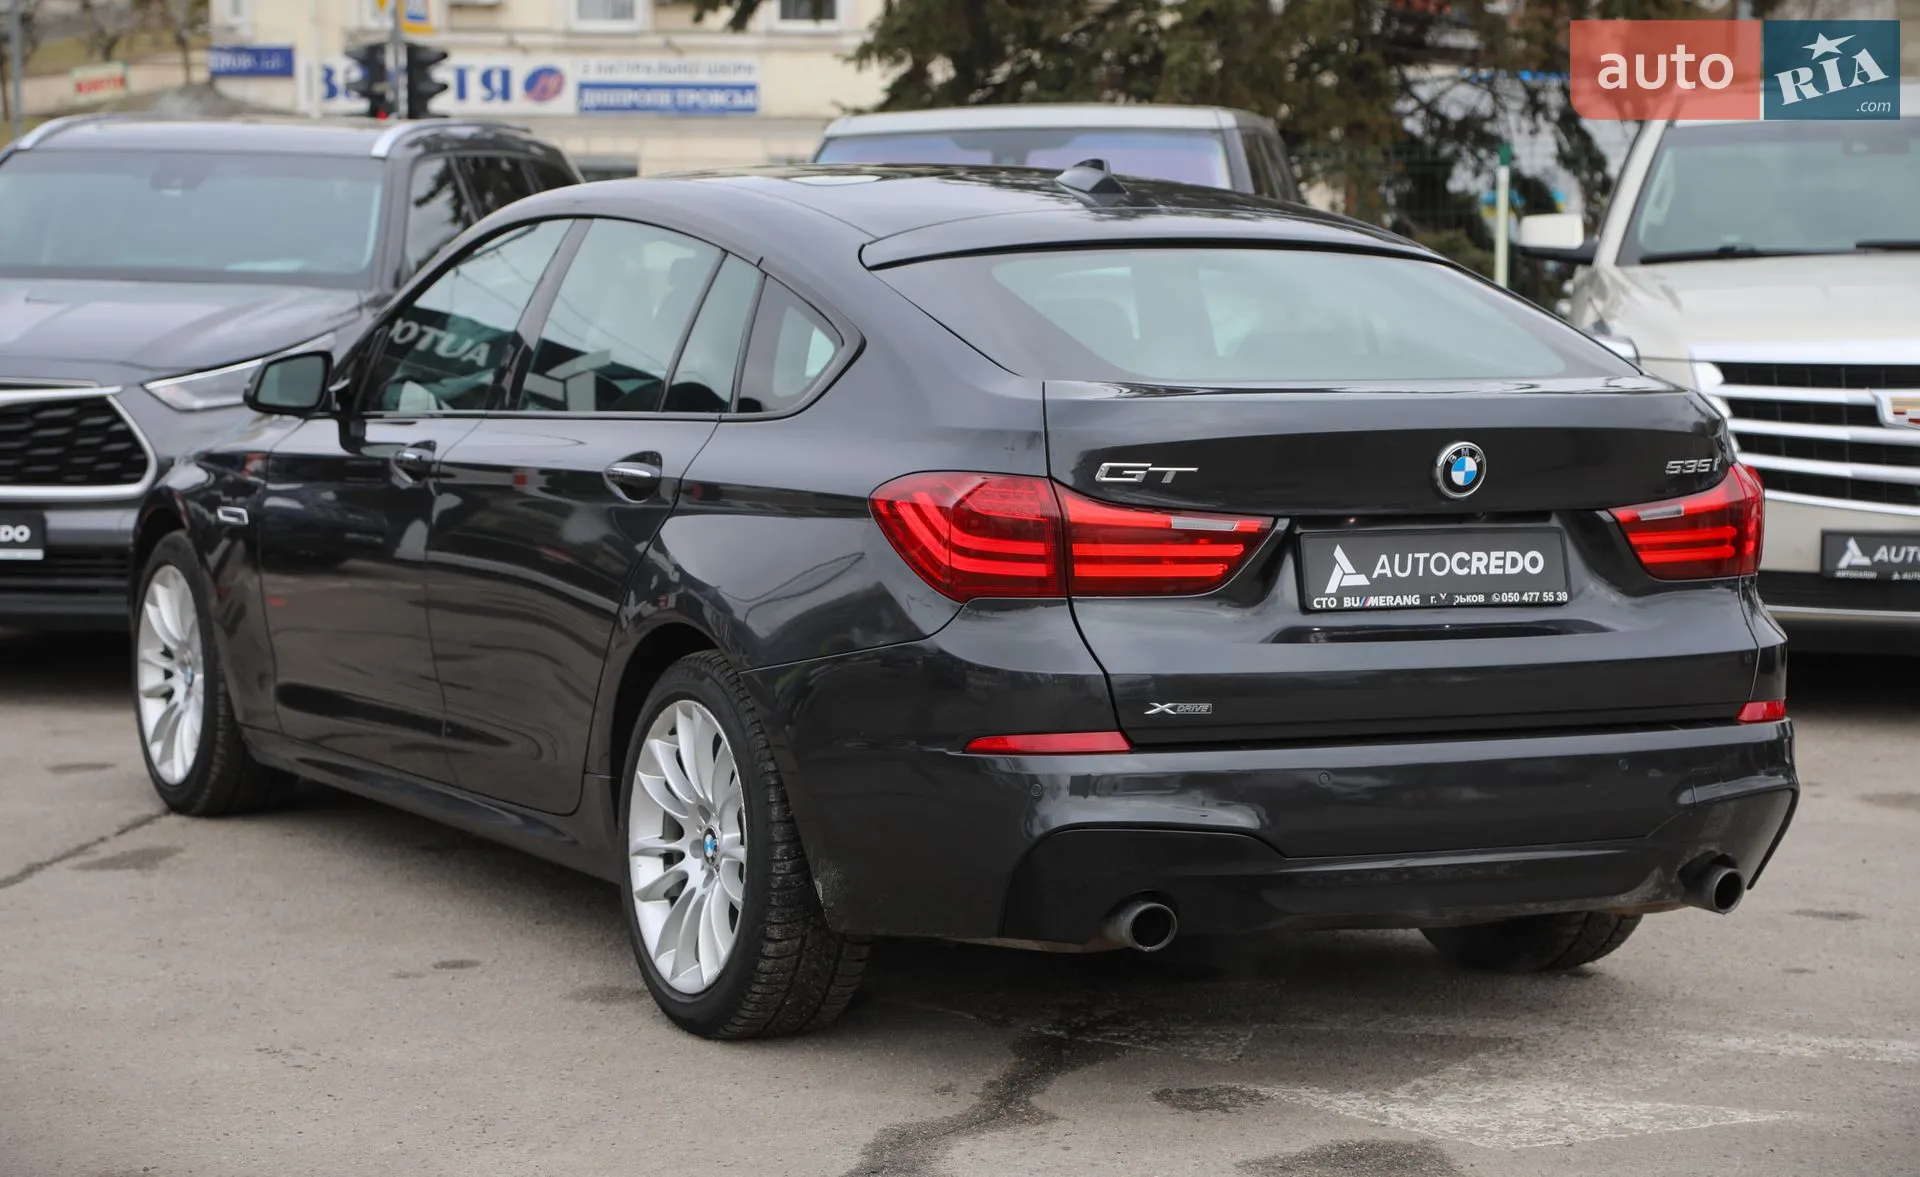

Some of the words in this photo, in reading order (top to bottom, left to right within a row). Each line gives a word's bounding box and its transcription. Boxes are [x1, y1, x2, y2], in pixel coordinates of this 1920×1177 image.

[1095, 462, 1199, 484] GT
[1372, 551, 1544, 579] AUTOCREDO
[1501, 592, 1520, 602] 050
[1522, 592, 1540, 602] 477
[1542, 592, 1555, 602] 55
[1556, 591, 1568, 601] 39
